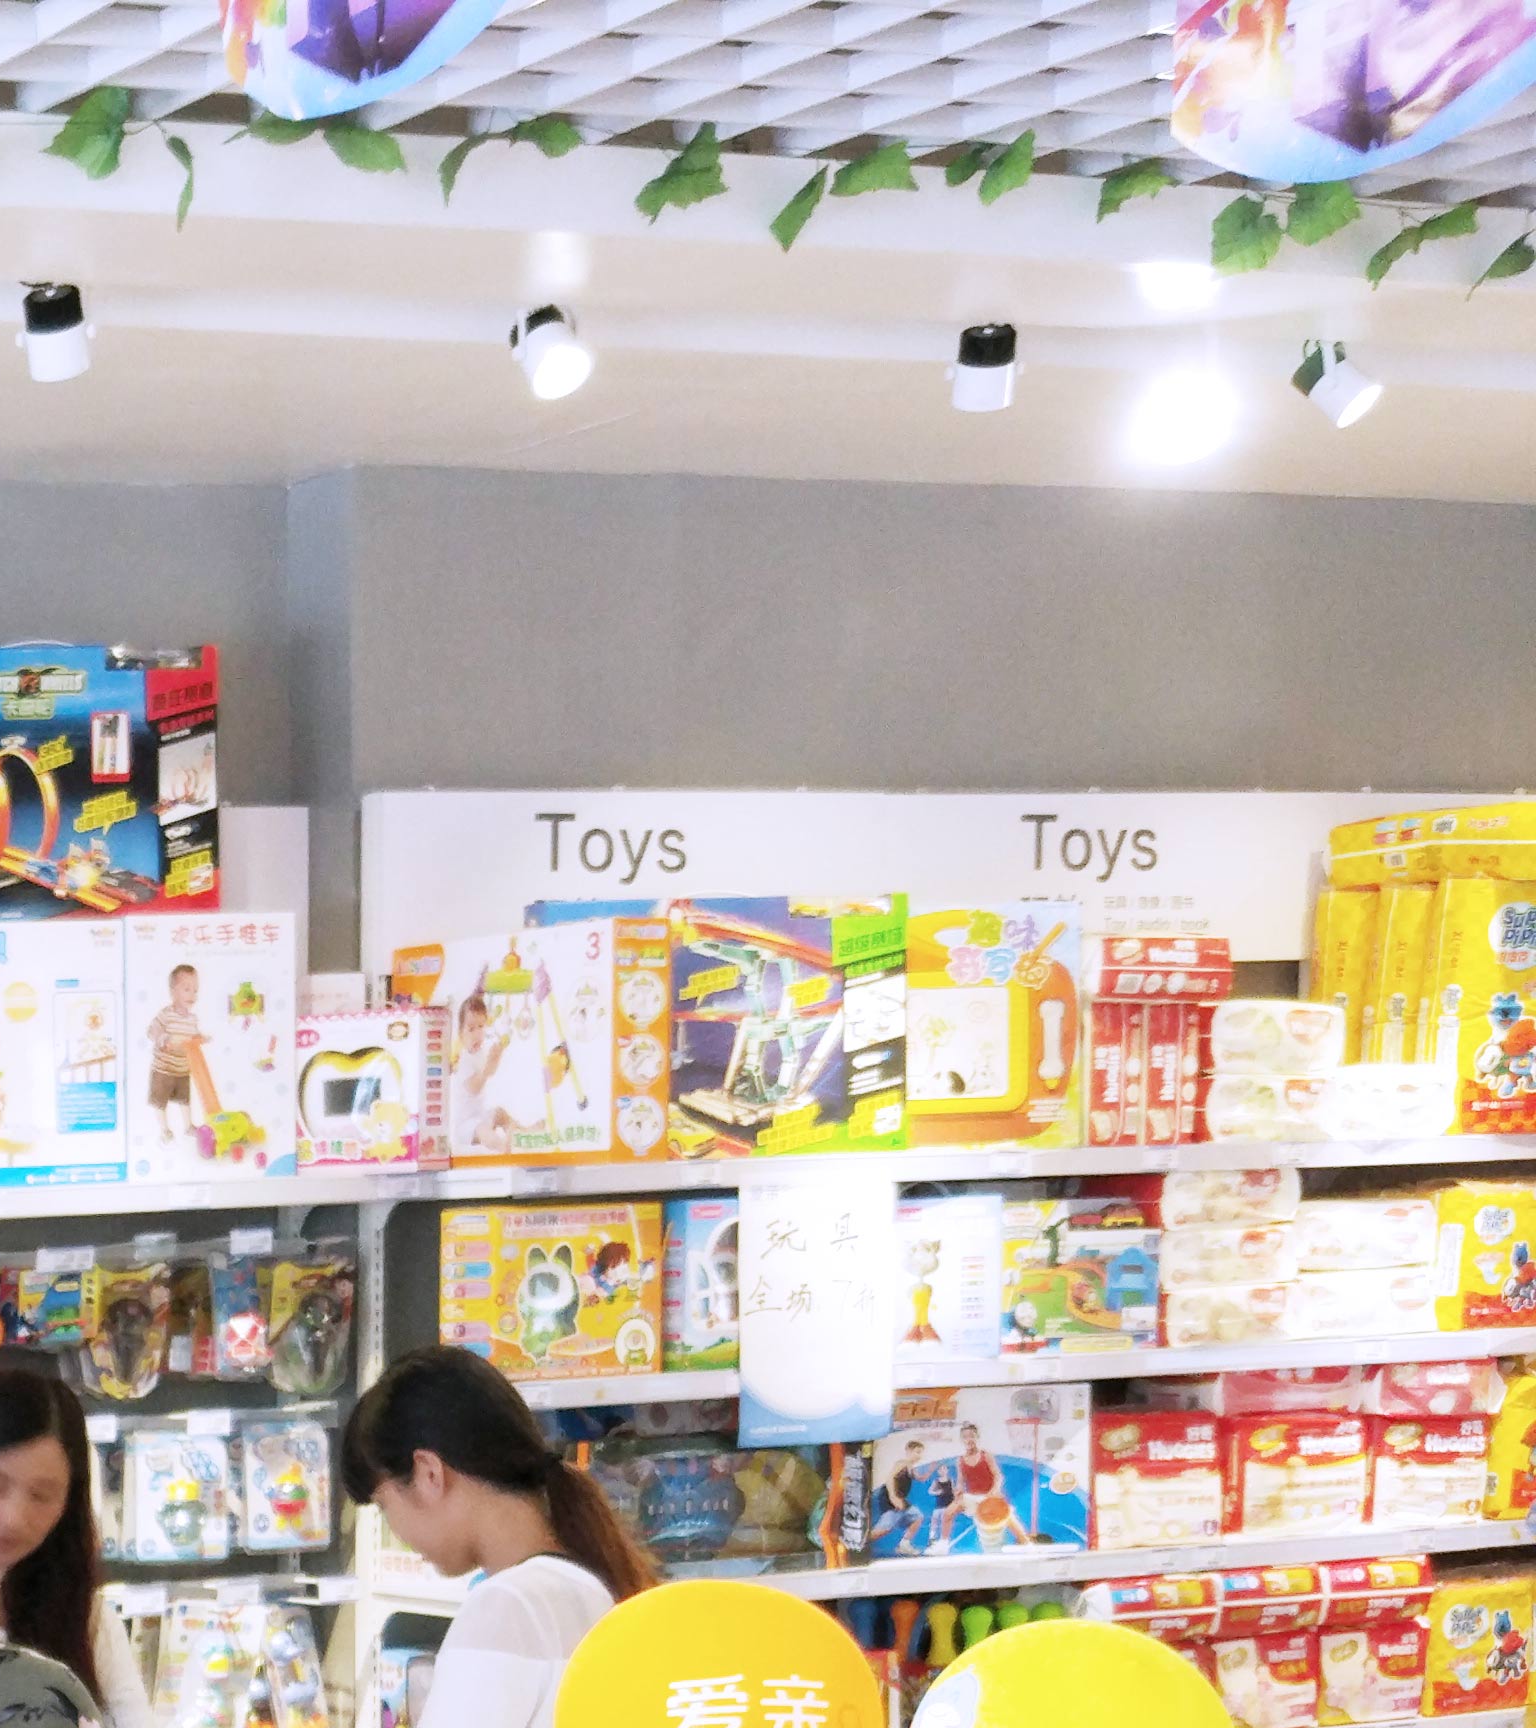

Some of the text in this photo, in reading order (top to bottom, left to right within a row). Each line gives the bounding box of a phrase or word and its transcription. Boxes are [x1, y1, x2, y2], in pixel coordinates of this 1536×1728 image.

[535, 813, 688, 884] Toys
[1020, 813, 1159, 883] Toys
[760, 1212, 860, 1260] 玩具
